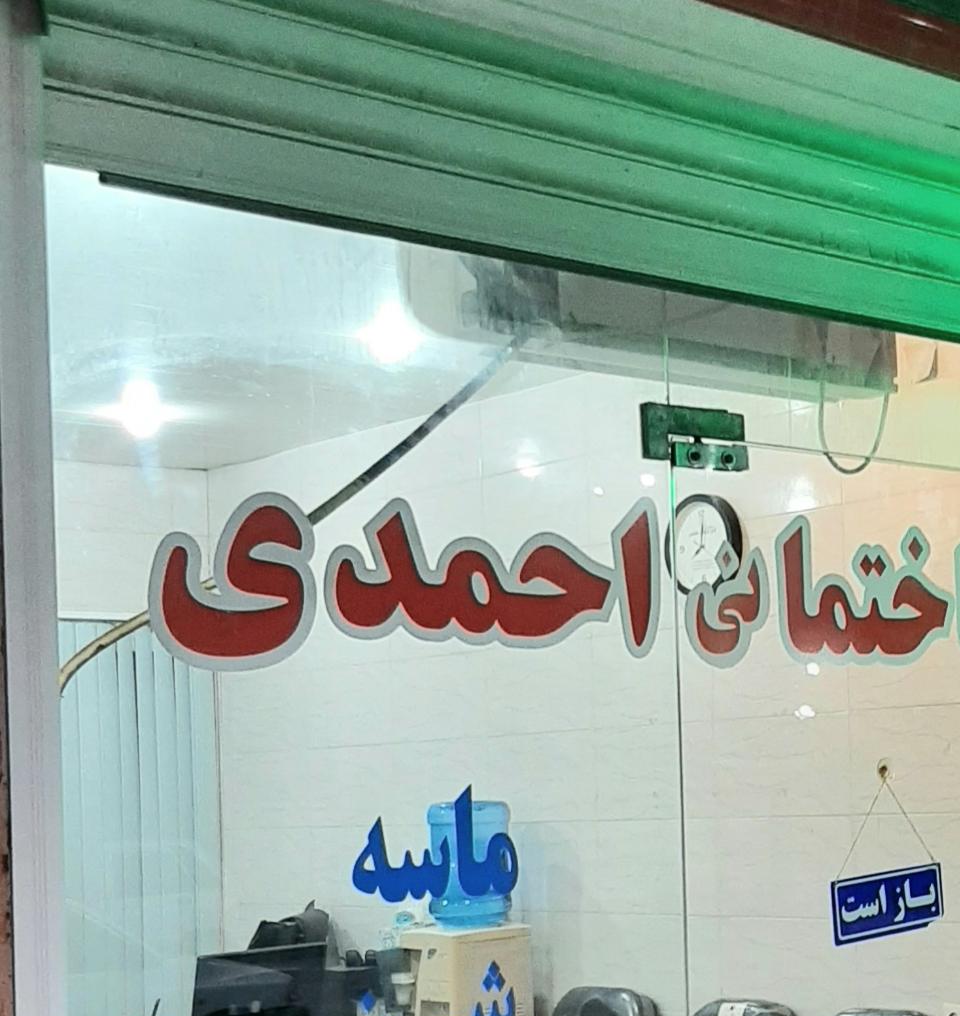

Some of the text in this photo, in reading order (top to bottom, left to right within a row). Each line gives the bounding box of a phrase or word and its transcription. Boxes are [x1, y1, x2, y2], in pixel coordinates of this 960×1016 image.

[149, 492, 661, 672] احمدی
[352, 783, 519, 904] ماسه
[841, 878, 937, 923] باز است
